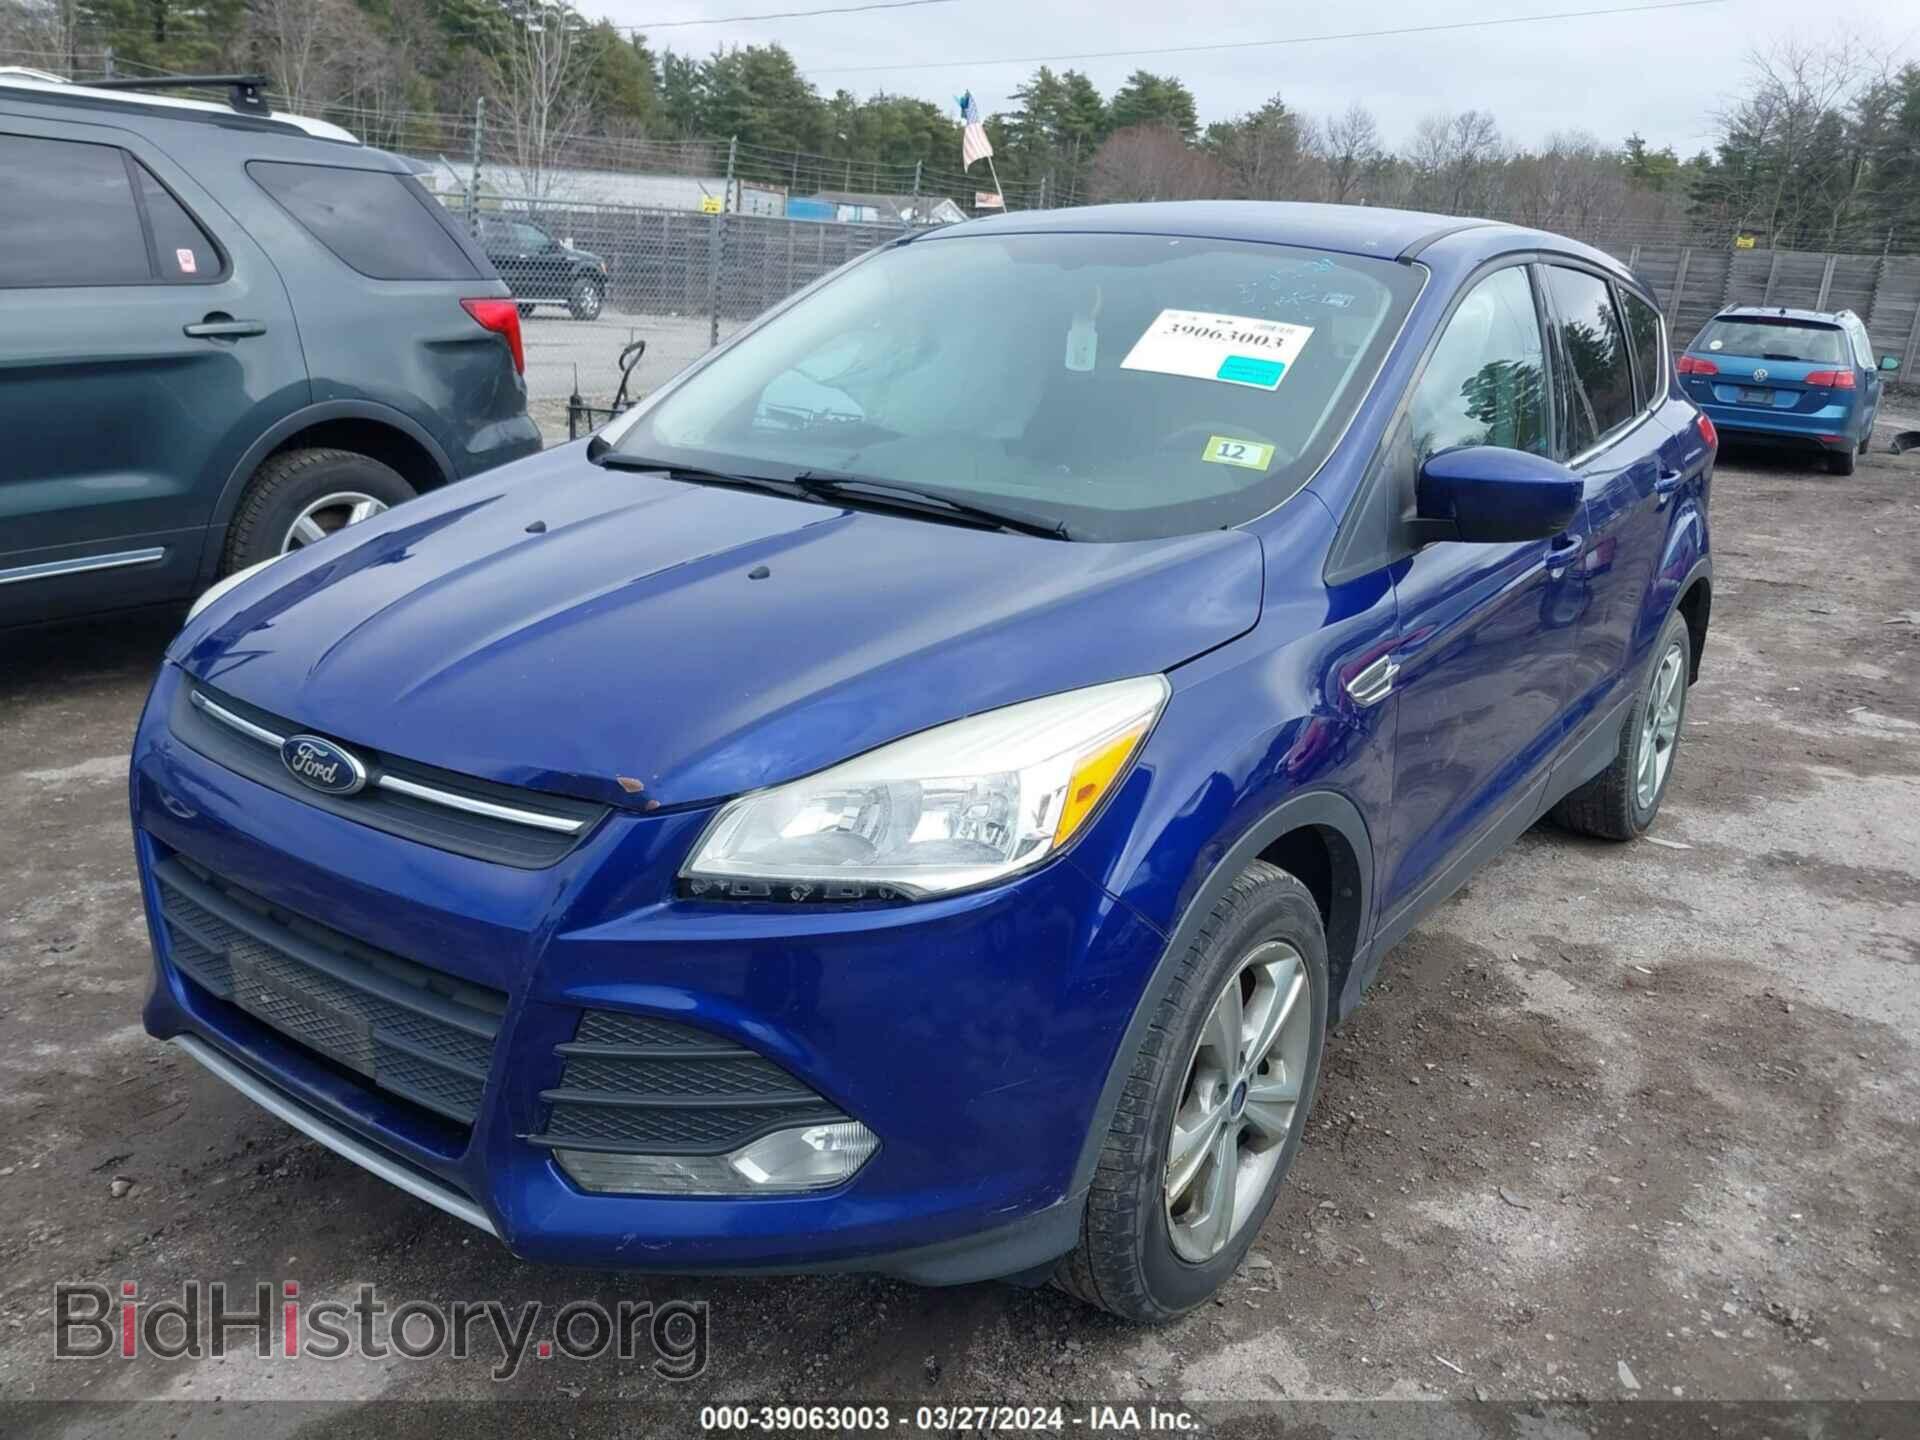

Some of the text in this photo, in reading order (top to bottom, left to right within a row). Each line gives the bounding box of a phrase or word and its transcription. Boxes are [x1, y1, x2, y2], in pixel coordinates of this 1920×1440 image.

[1163, 322, 1285, 348] 39063003
[1217, 442, 1247, 461] 12
[292, 742, 339, 784] Ford
